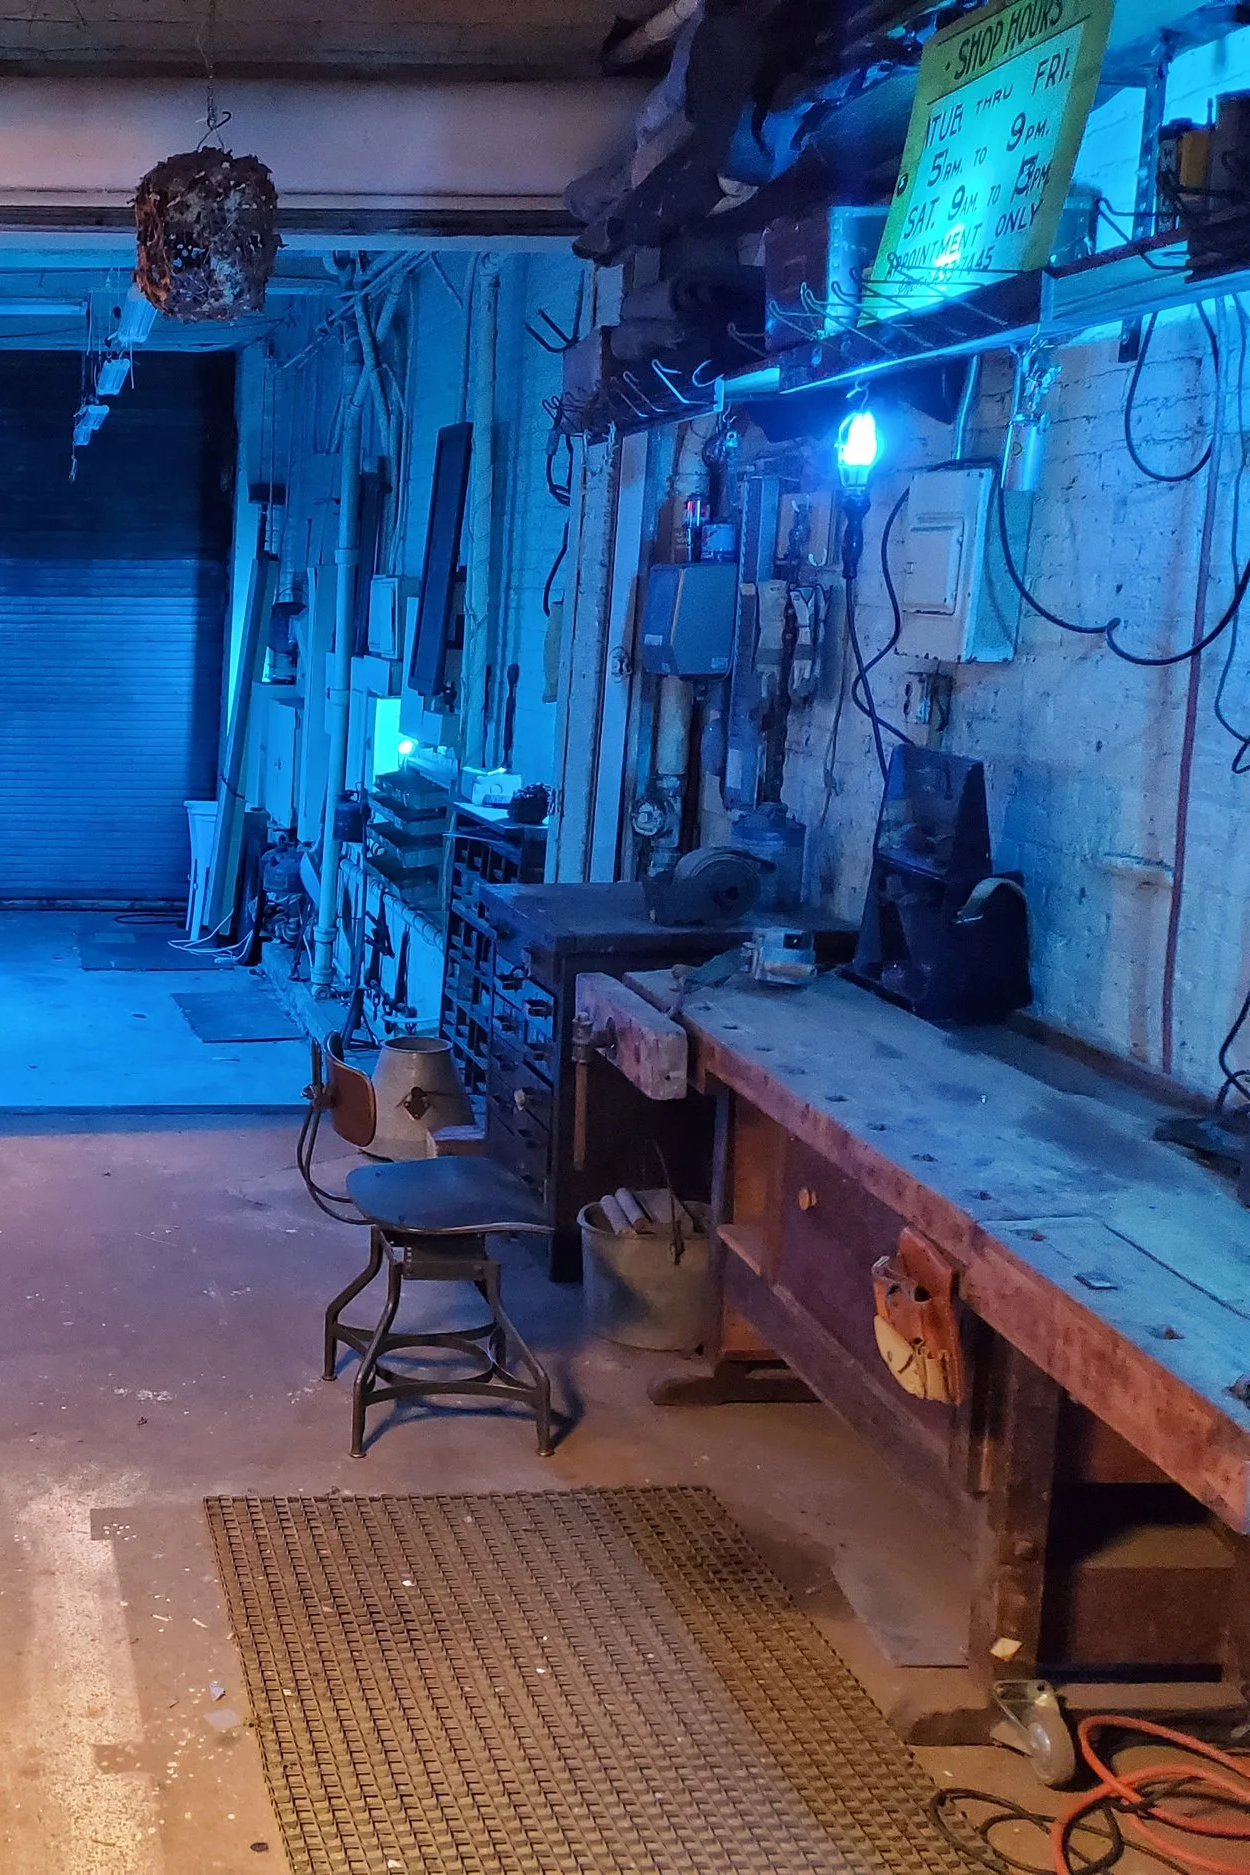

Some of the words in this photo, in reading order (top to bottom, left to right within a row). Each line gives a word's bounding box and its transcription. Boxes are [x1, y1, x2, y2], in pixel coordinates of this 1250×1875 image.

[953, 20, 1004, 80] SHOP
[975, 83, 1014, 113] THRU
[1031, 47, 1070, 96] FRI.
[973, 146, 988, 167] TO
[903, 196, 941, 240] SAT.
[987, 184, 1002, 207] TO
[994, 199, 1045, 238] ONLY
